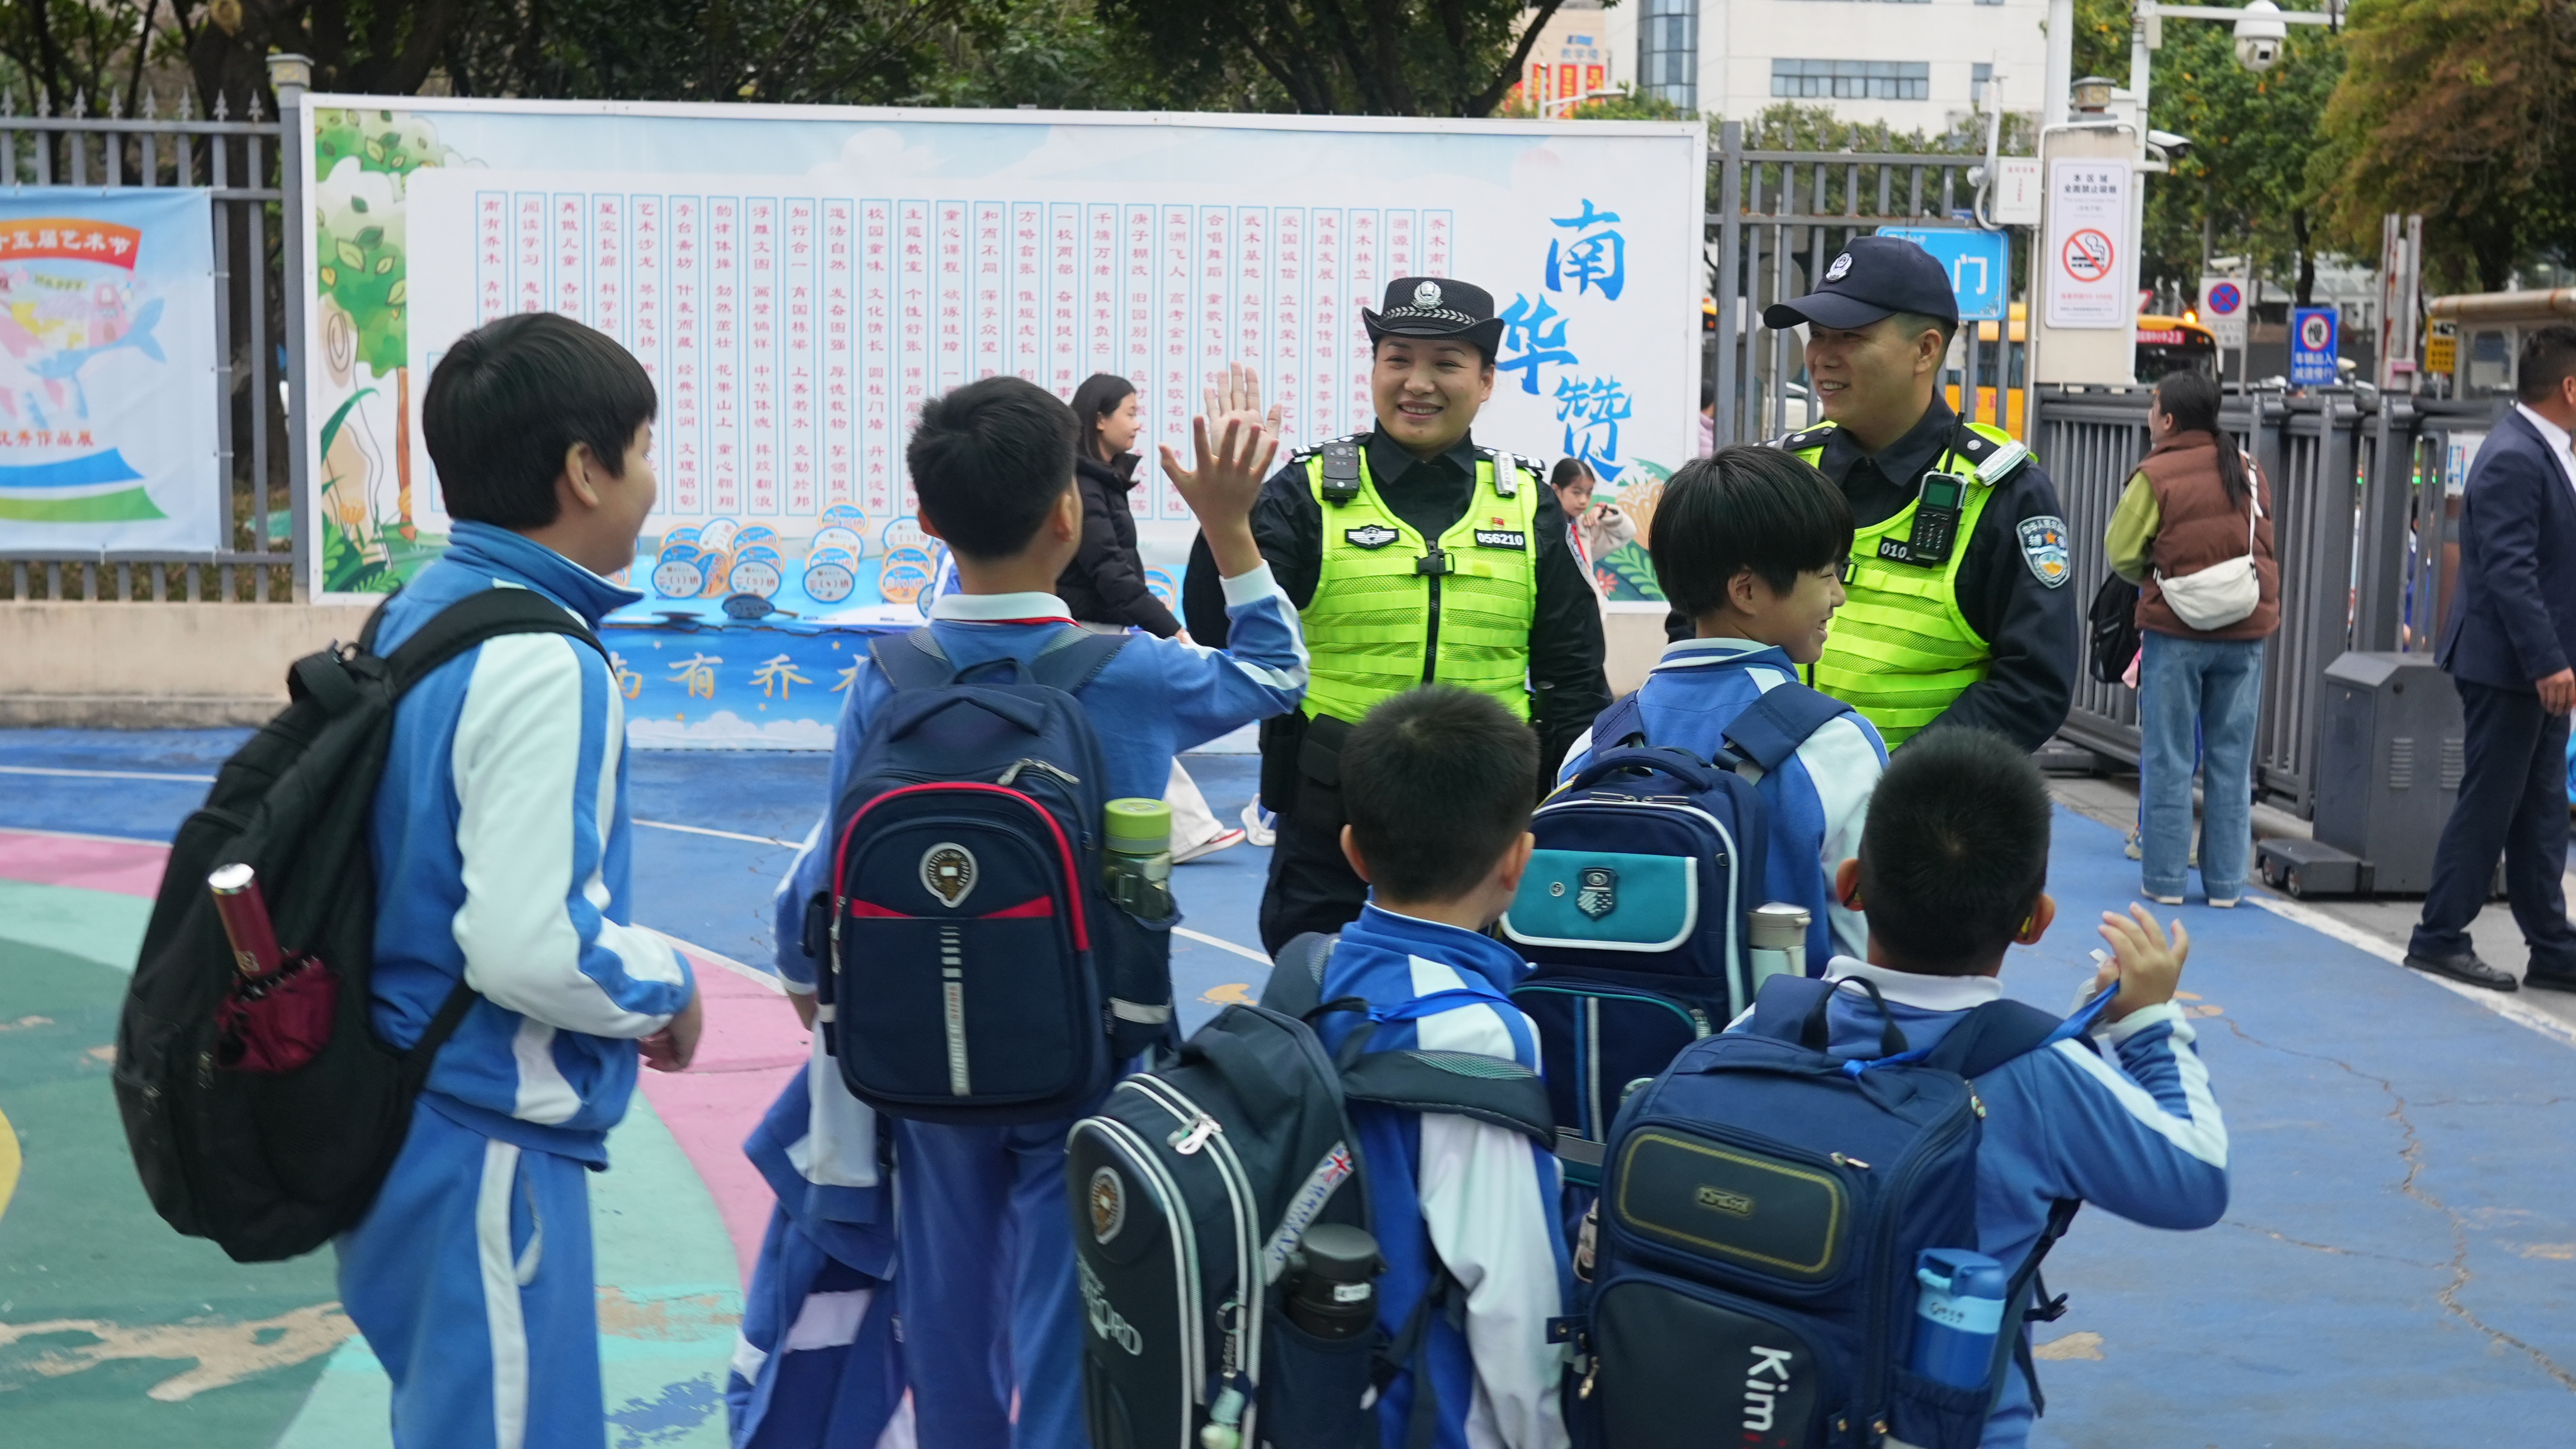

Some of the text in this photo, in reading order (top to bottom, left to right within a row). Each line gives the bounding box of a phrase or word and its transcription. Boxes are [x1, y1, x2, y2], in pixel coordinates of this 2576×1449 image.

[523, 202, 539, 266] 阅读学习
[562, 201, 580, 312] 再做儿童 杏坛
[600, 202, 617, 267] 星空长廊
[638, 203, 657, 268] 艺术沙龙
[715, 205, 732, 270] 韵律体操
[792, 207, 809, 268] 知行合一
[831, 207, 847, 271] 道法自然
[868, 208, 885, 272] 校园童味
[906, 209, 923, 273] 主题教室
[944, 209, 960, 273] 童心课程
[982, 210, 998, 274] 和而不同
[1058, 214, 1074, 275] 一校两部
[1169, 214, 1187, 278] 亚洲飞人
[1208, 214, 1224, 278] 合唱舞蹈
[1245, 215, 1261, 280] 武术基地
[1281, 216, 1298, 280] 爱国诚信
[1319, 216, 1335, 281] 健康发展
[1356, 217, 1372, 281] 秀木林立
[1954, 253, 1987, 295] 门
[639, 283, 657, 347] 琴声悠扬
[792, 286, 810, 350] 育国栋梁
[830, 287, 848, 351] 发奋图强
[868, 288, 884, 352] 文化情长
[906, 288, 923, 352] 个性舒张
[981, 289, 999, 353] 深孚众望
[1168, 292, 1187, 356] 高考金榜
[1206, 293, 1224, 357] 童歌飞扬
[1280, 295, 1298, 359] 立德荣光
[2308, 323, 2323, 343] 慢
[679, 363, 695, 427] 经典浸润
[717, 364, 733, 428] 花果山上
[755, 364, 771, 428] 中华体魄
[792, 366, 809, 429] 上善若水
[830, 366, 847, 430] 厚德载物
[1168, 371, 1186, 434] 美欧名校
[1316, 373, 1334, 437] 莘莘学子
[679, 443, 695, 506] 文理昭彰
[718, 443, 735, 506] 童心翱翔
[756, 444, 772, 507] 摔跤翻浪
[870, 446, 886, 509] 丹青泛黄
[1476, 532, 1524, 546] 056210
[1880, 542, 1913, 561] 010
